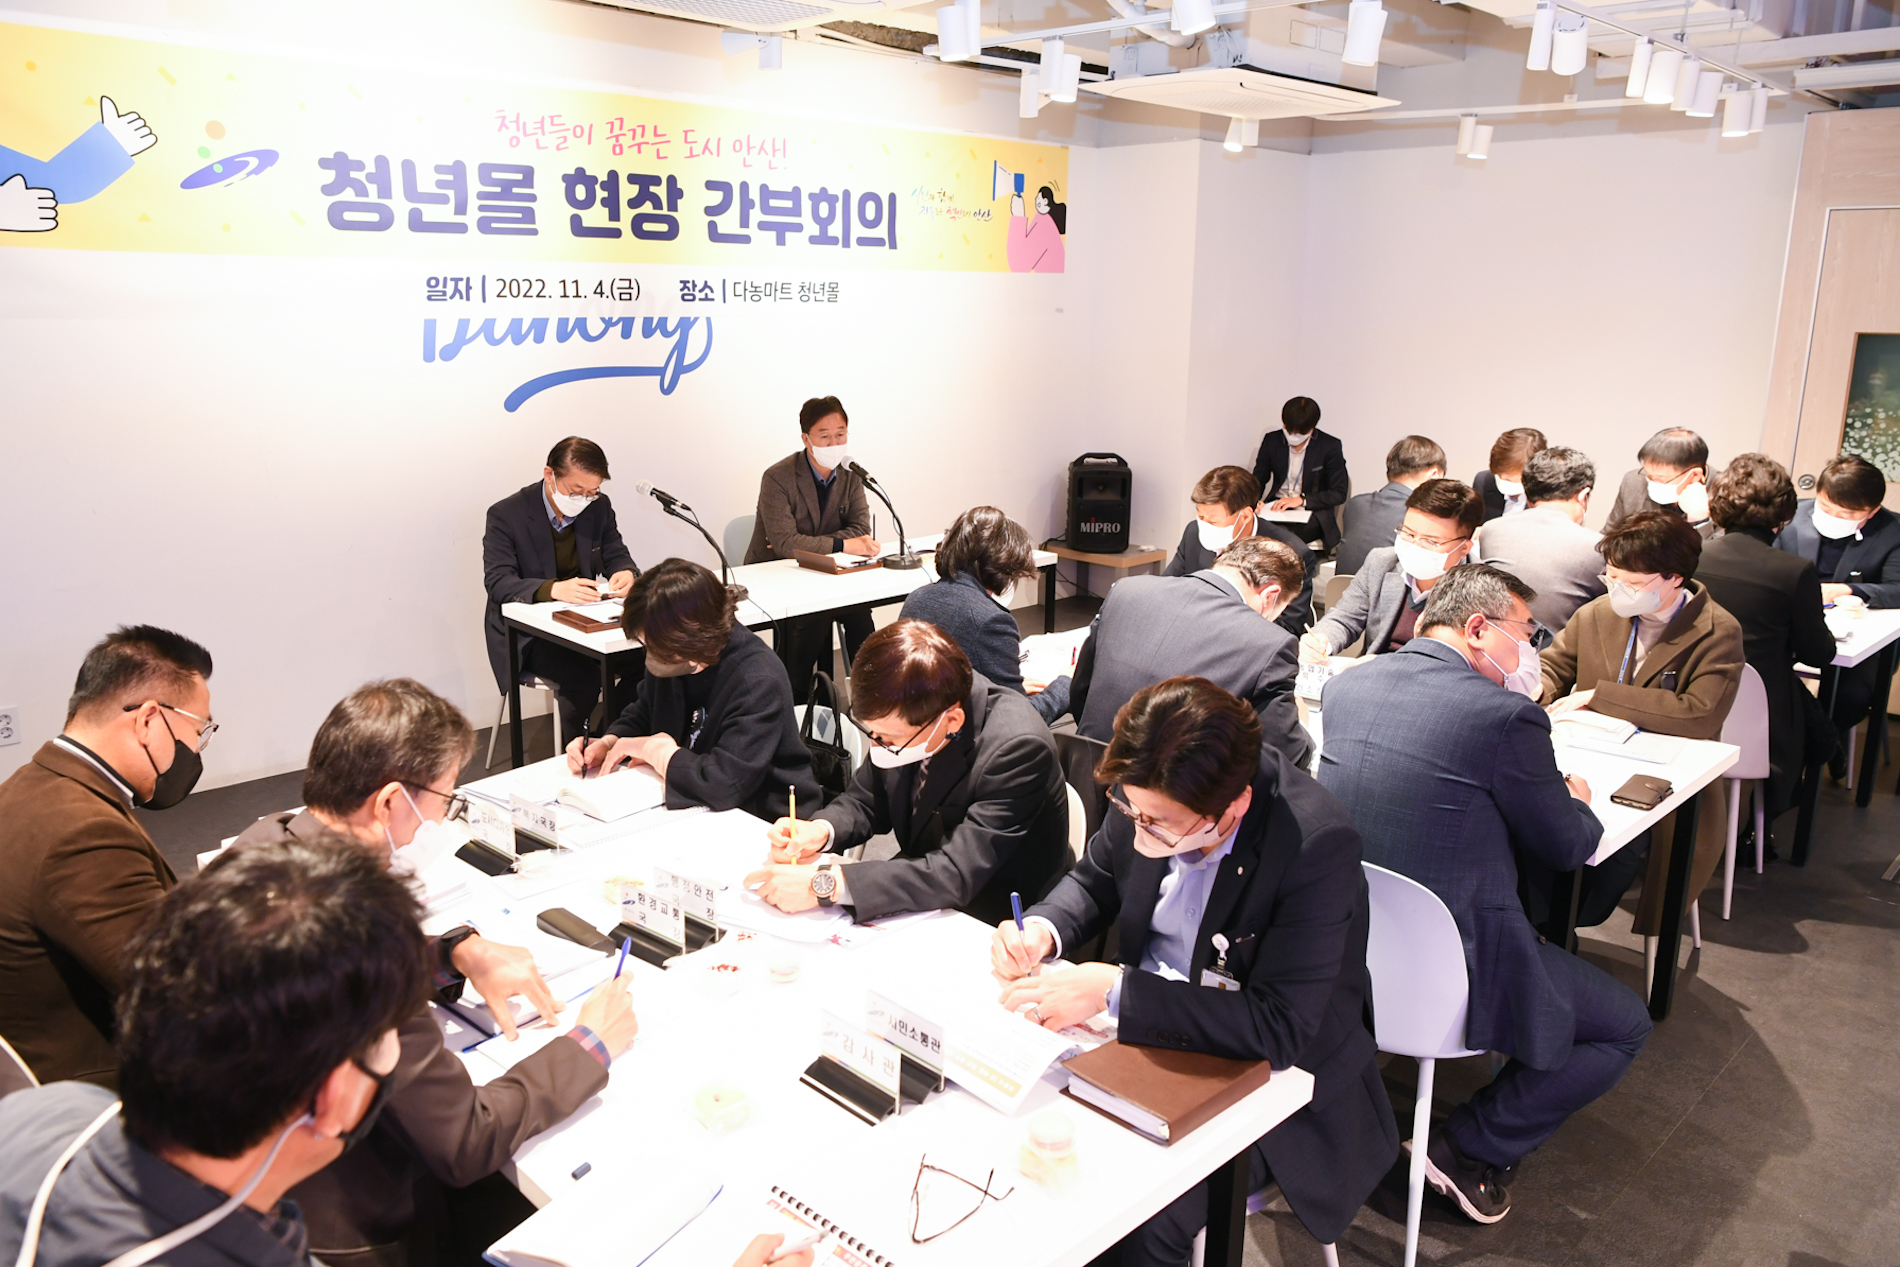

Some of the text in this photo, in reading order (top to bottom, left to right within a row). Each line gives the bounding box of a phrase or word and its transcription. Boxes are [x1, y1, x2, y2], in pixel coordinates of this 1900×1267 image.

[494, 109, 787, 170] 청년들이 꿈꾸는 도시 안산!
[318, 151, 898, 250] 청년몰 현장 간부회의
[973, 208, 993, 222] 안산
[426, 276, 840, 303] 일자 2022. 11. 4.(금) 장소 다농마트 청년몰
[671, 875, 714, 902] 행정안전
[637, 892, 680, 921] 환경교통
[888, 1014, 941, 1055] 시민소통관
